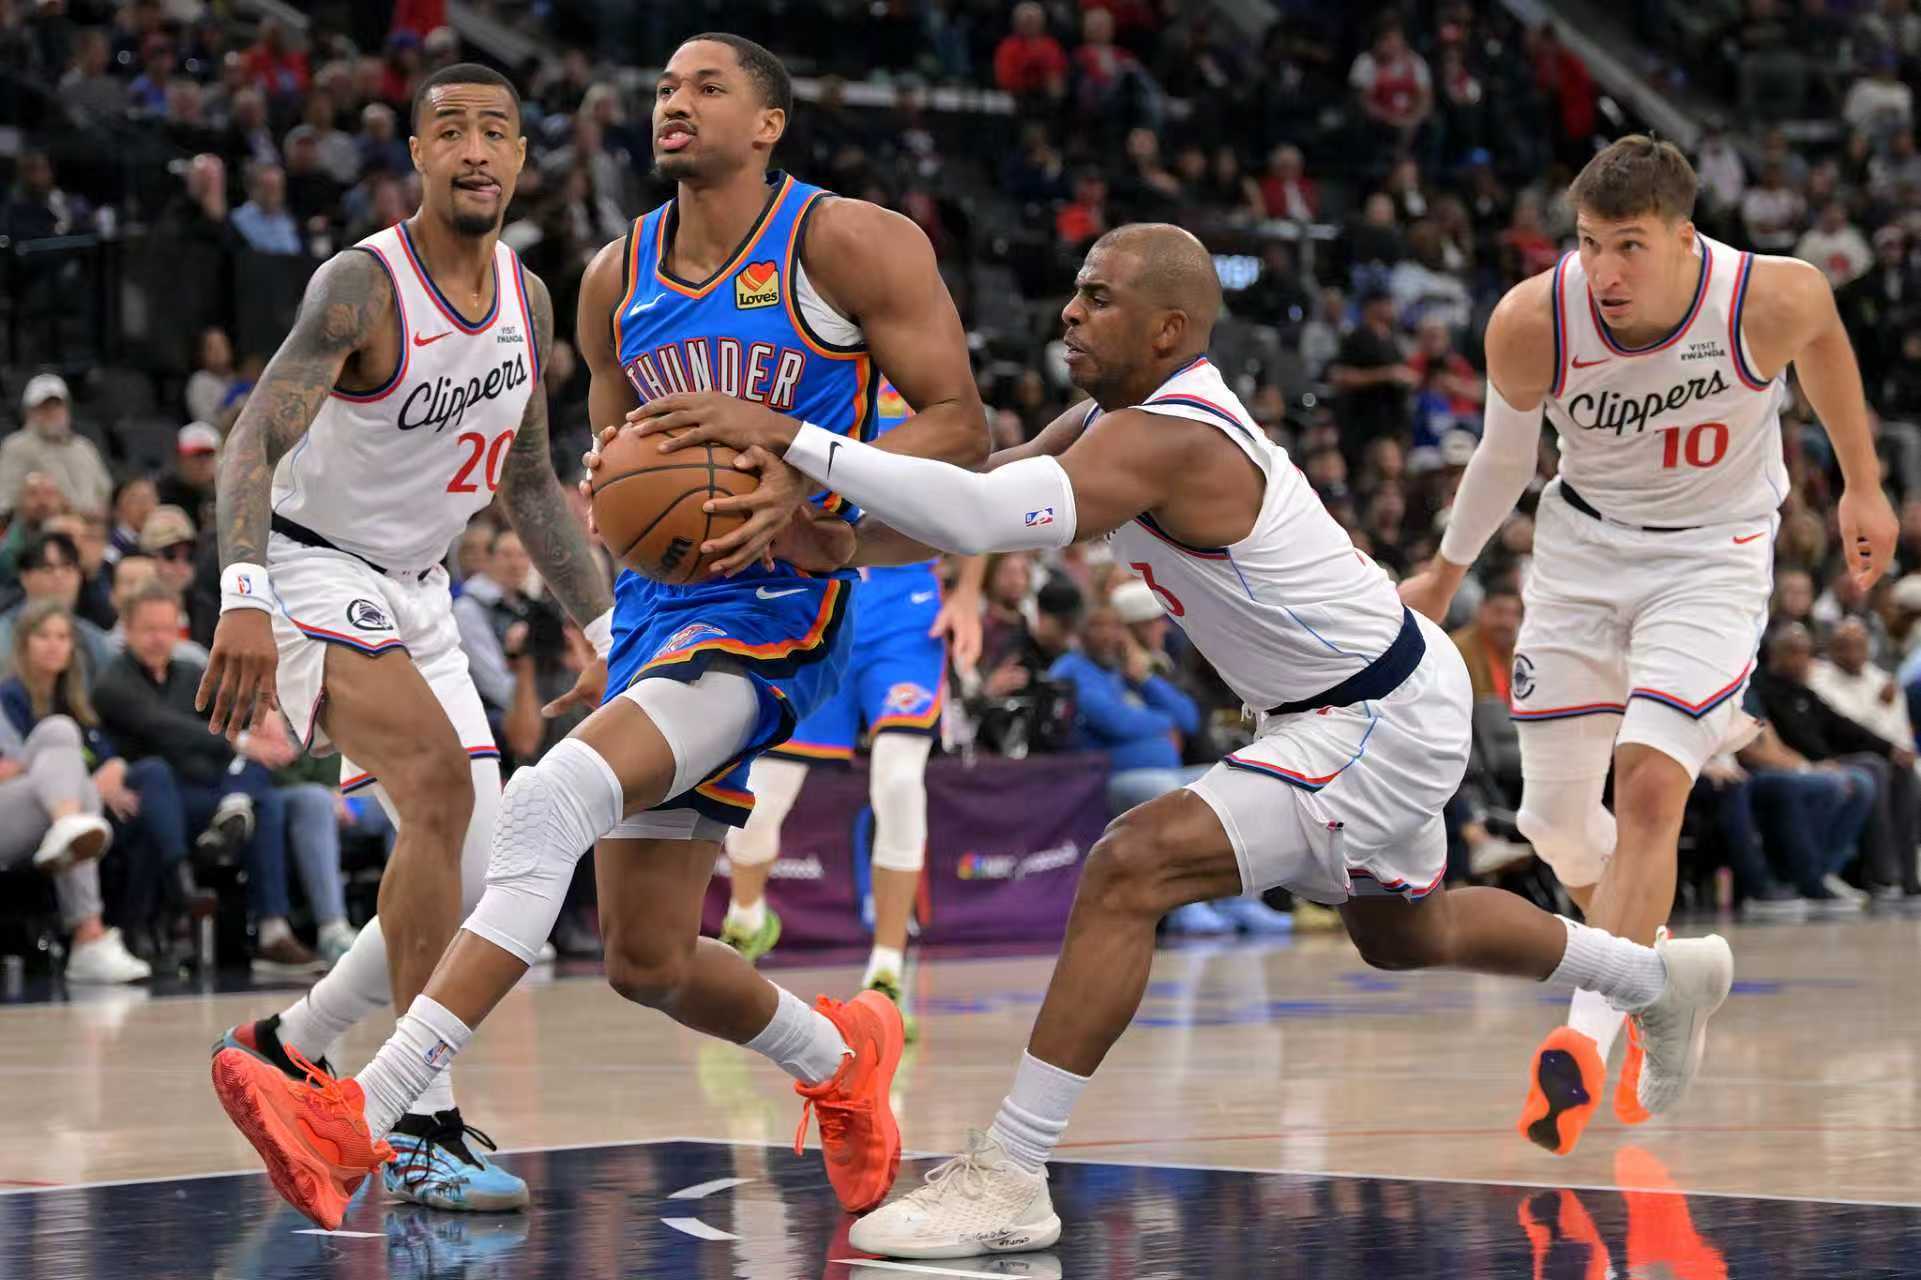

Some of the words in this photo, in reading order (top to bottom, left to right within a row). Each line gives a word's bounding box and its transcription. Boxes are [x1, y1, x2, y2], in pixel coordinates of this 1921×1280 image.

[1689, 341, 1716, 351] VISIT
[398, 352, 528, 433] Clippers
[1568, 369, 1731, 437] Clippers
[445, 428, 515, 493] 20
[1654, 421, 1730, 470] 10
